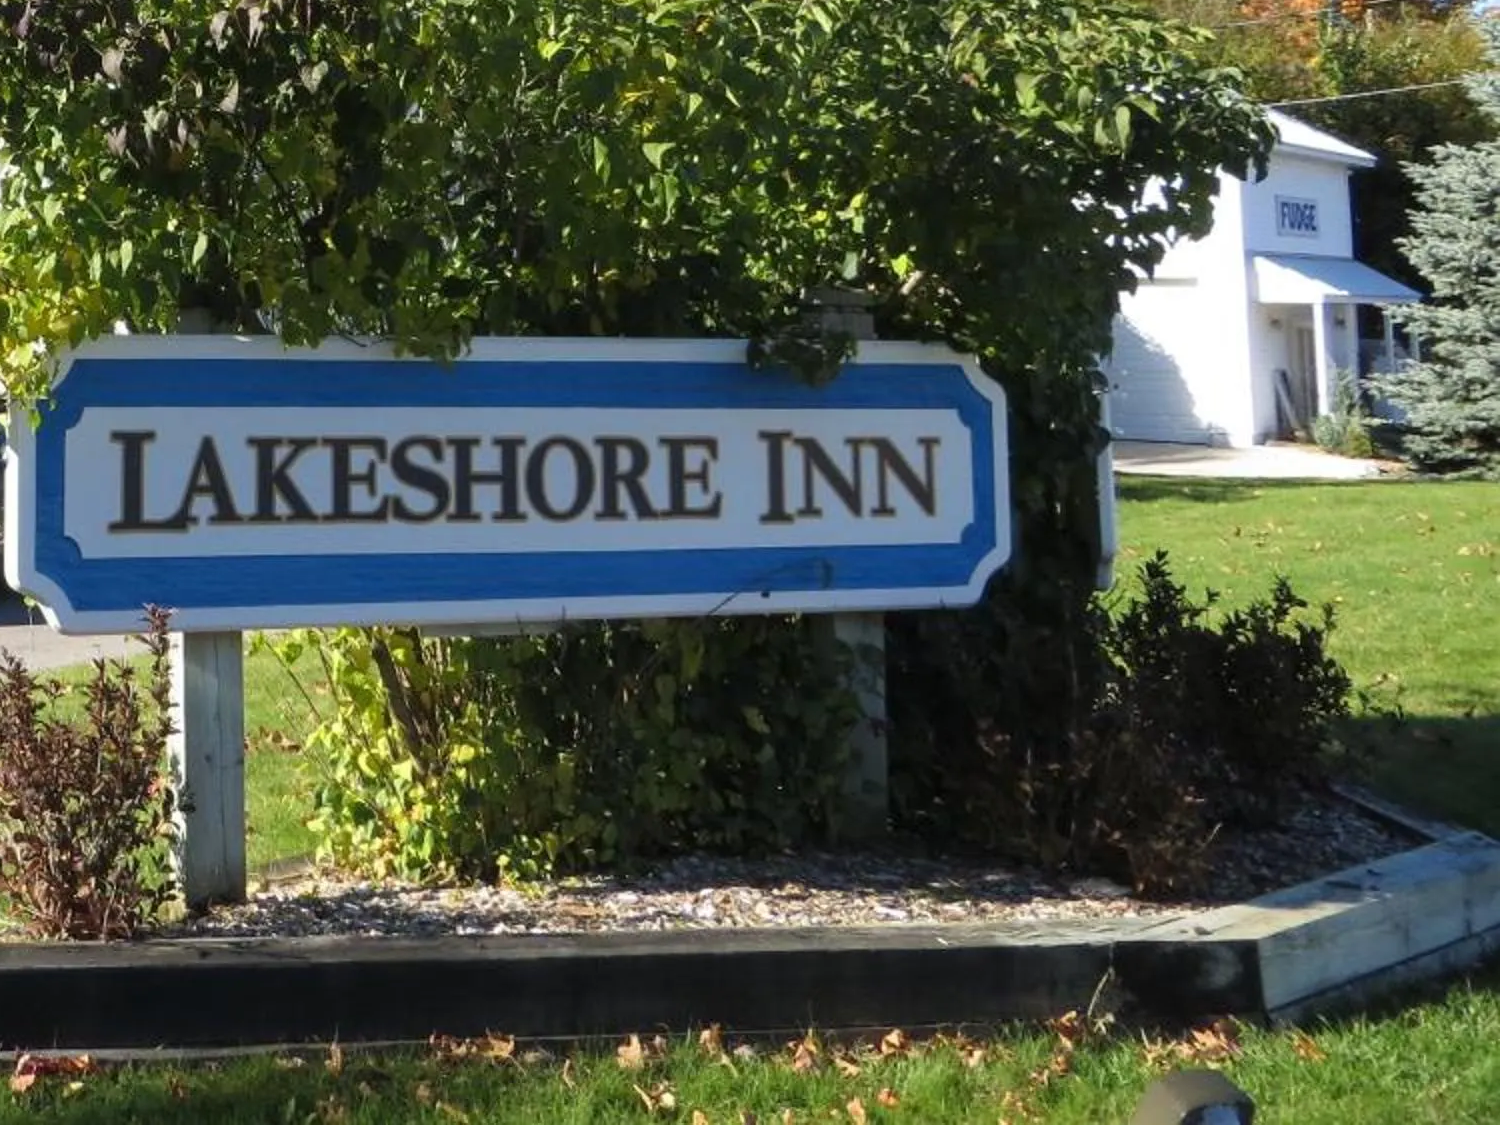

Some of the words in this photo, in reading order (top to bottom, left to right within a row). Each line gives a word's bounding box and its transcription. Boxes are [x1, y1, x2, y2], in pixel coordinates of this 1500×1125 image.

[1281, 201, 1317, 231] FUDGE
[107, 430, 721, 533] LAKESHORE
[757, 430, 941, 525] INN
